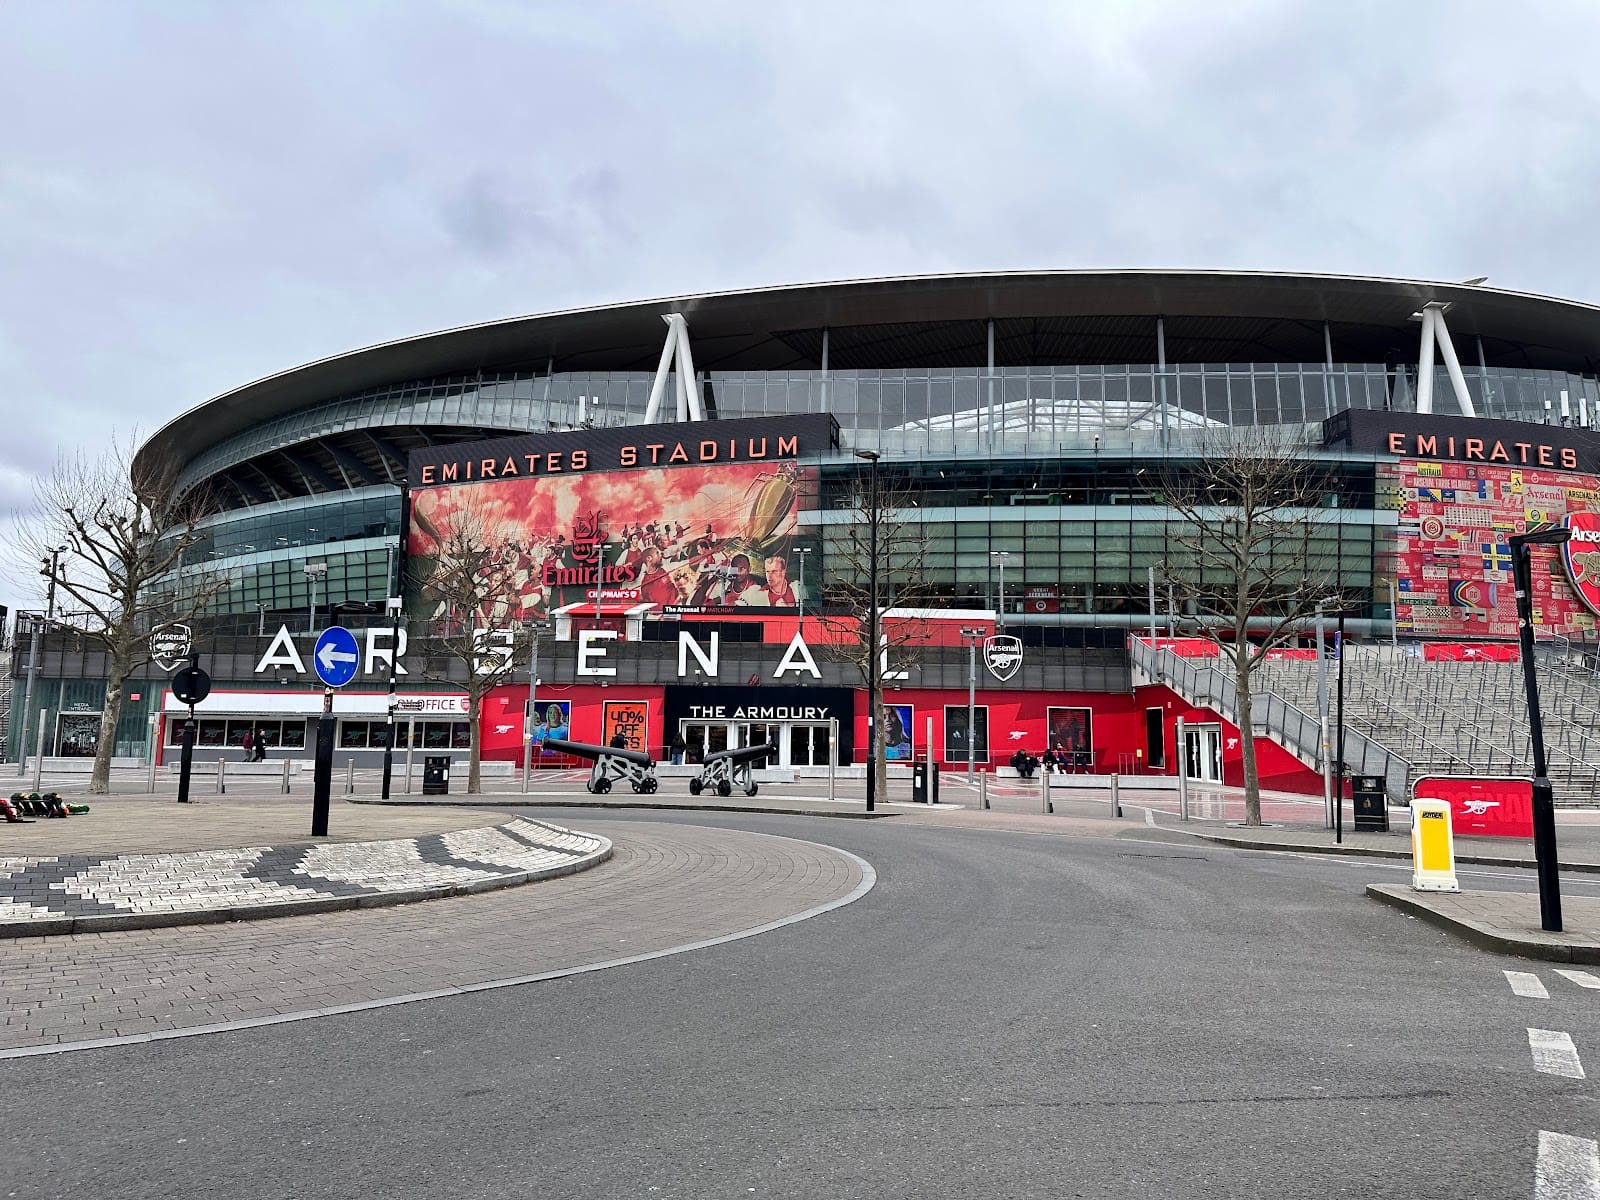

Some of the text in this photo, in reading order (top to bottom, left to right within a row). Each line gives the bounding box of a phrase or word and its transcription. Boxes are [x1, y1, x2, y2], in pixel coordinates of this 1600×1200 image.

[1388, 432, 1577, 469] EMIRATES
[421, 435, 798, 484] EMIRATES STADIUM
[1526, 487, 1564, 500] Arsenal
[1568, 490, 1592, 499] ARSENAL
[542, 563, 636, 586] Emirates
[1488, 622, 1518, 635] ARSENAL
[155, 632, 187, 641] Arsenal
[254, 623, 909, 680] ARSENAL
[990, 644, 1018, 652] Arsenal
[611, 710, 644, 723] 40%
[689, 705, 829, 719] THE ARMOURY
[614, 724, 640, 736] OFF
